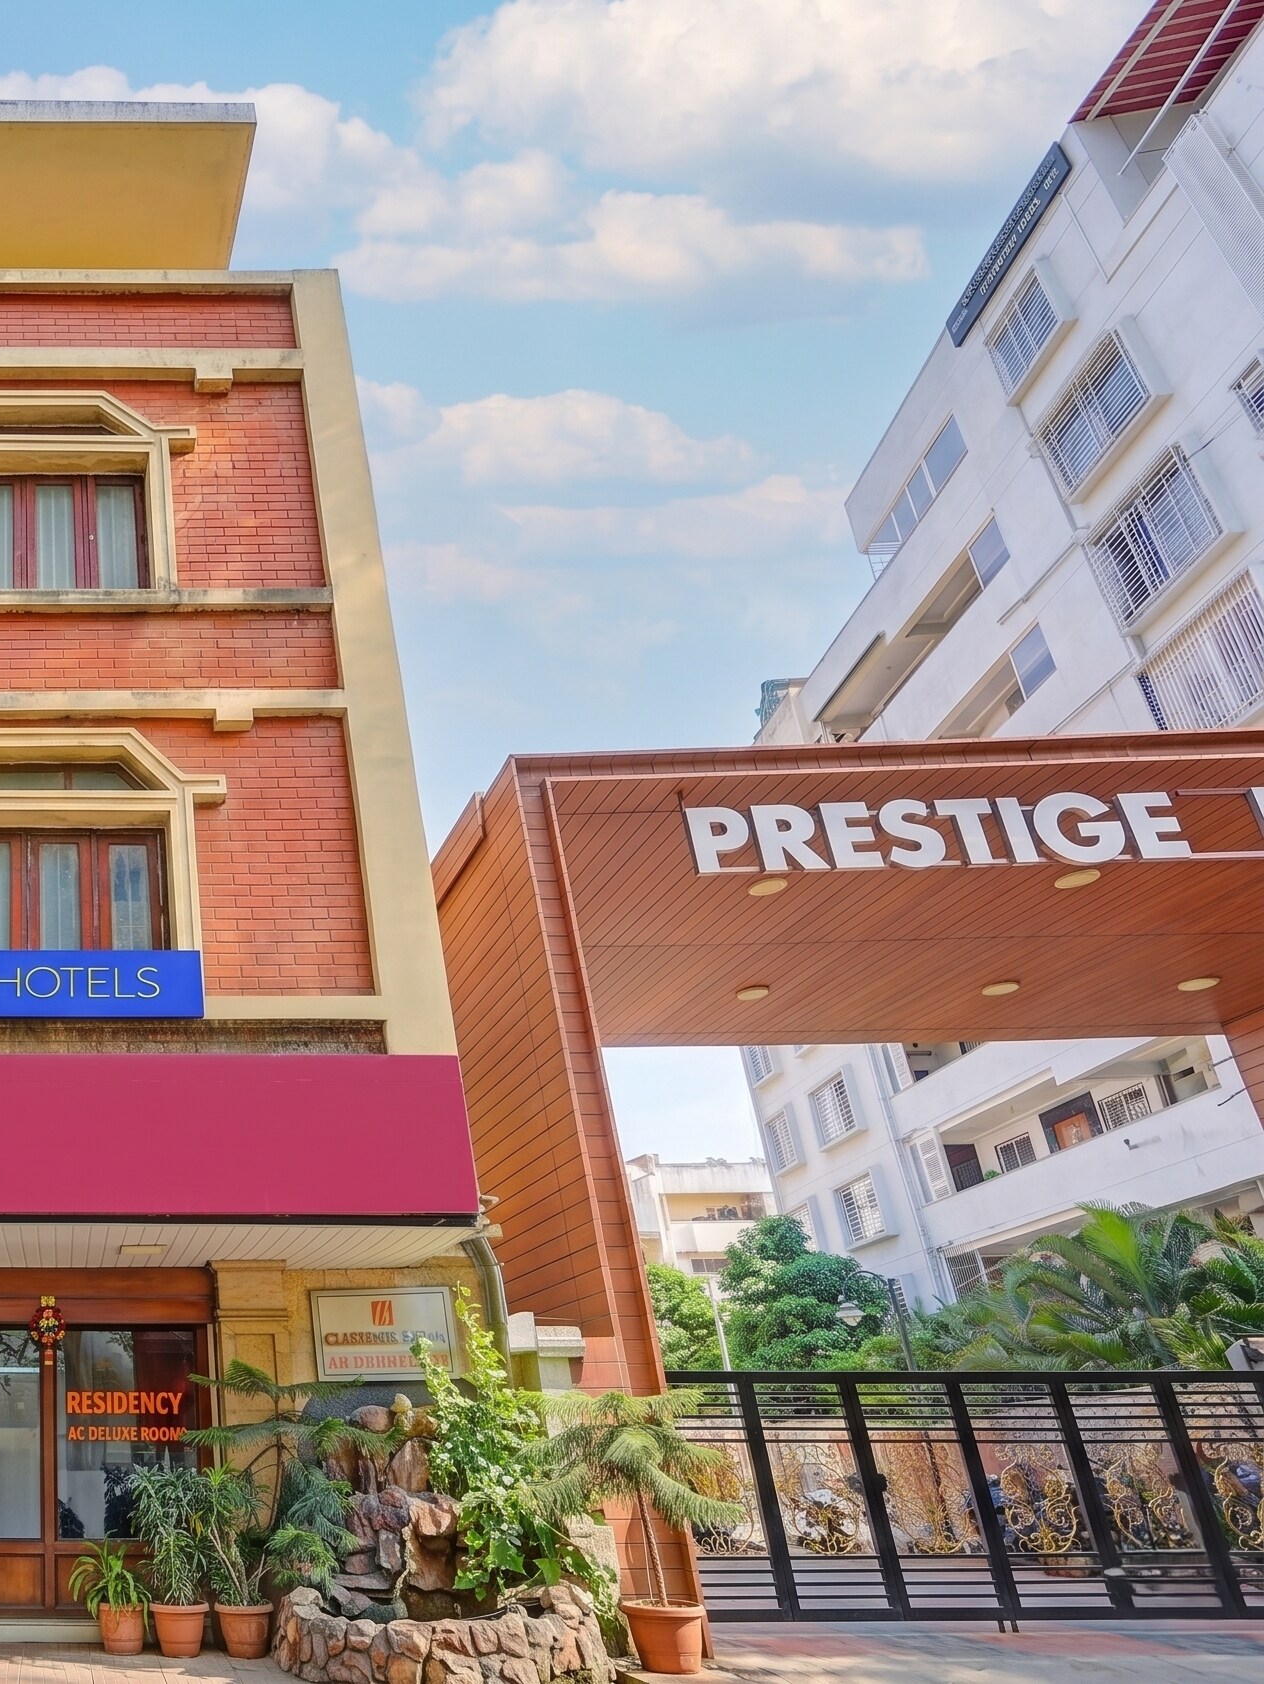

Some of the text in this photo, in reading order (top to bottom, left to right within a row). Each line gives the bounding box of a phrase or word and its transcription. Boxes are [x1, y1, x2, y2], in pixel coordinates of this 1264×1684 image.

[683, 791, 1193, 875] PRESTIGE
[67, 1391, 183, 1415] RESIDENCY
[68, 1426, 188, 1441] AC DELUXE ROOM
